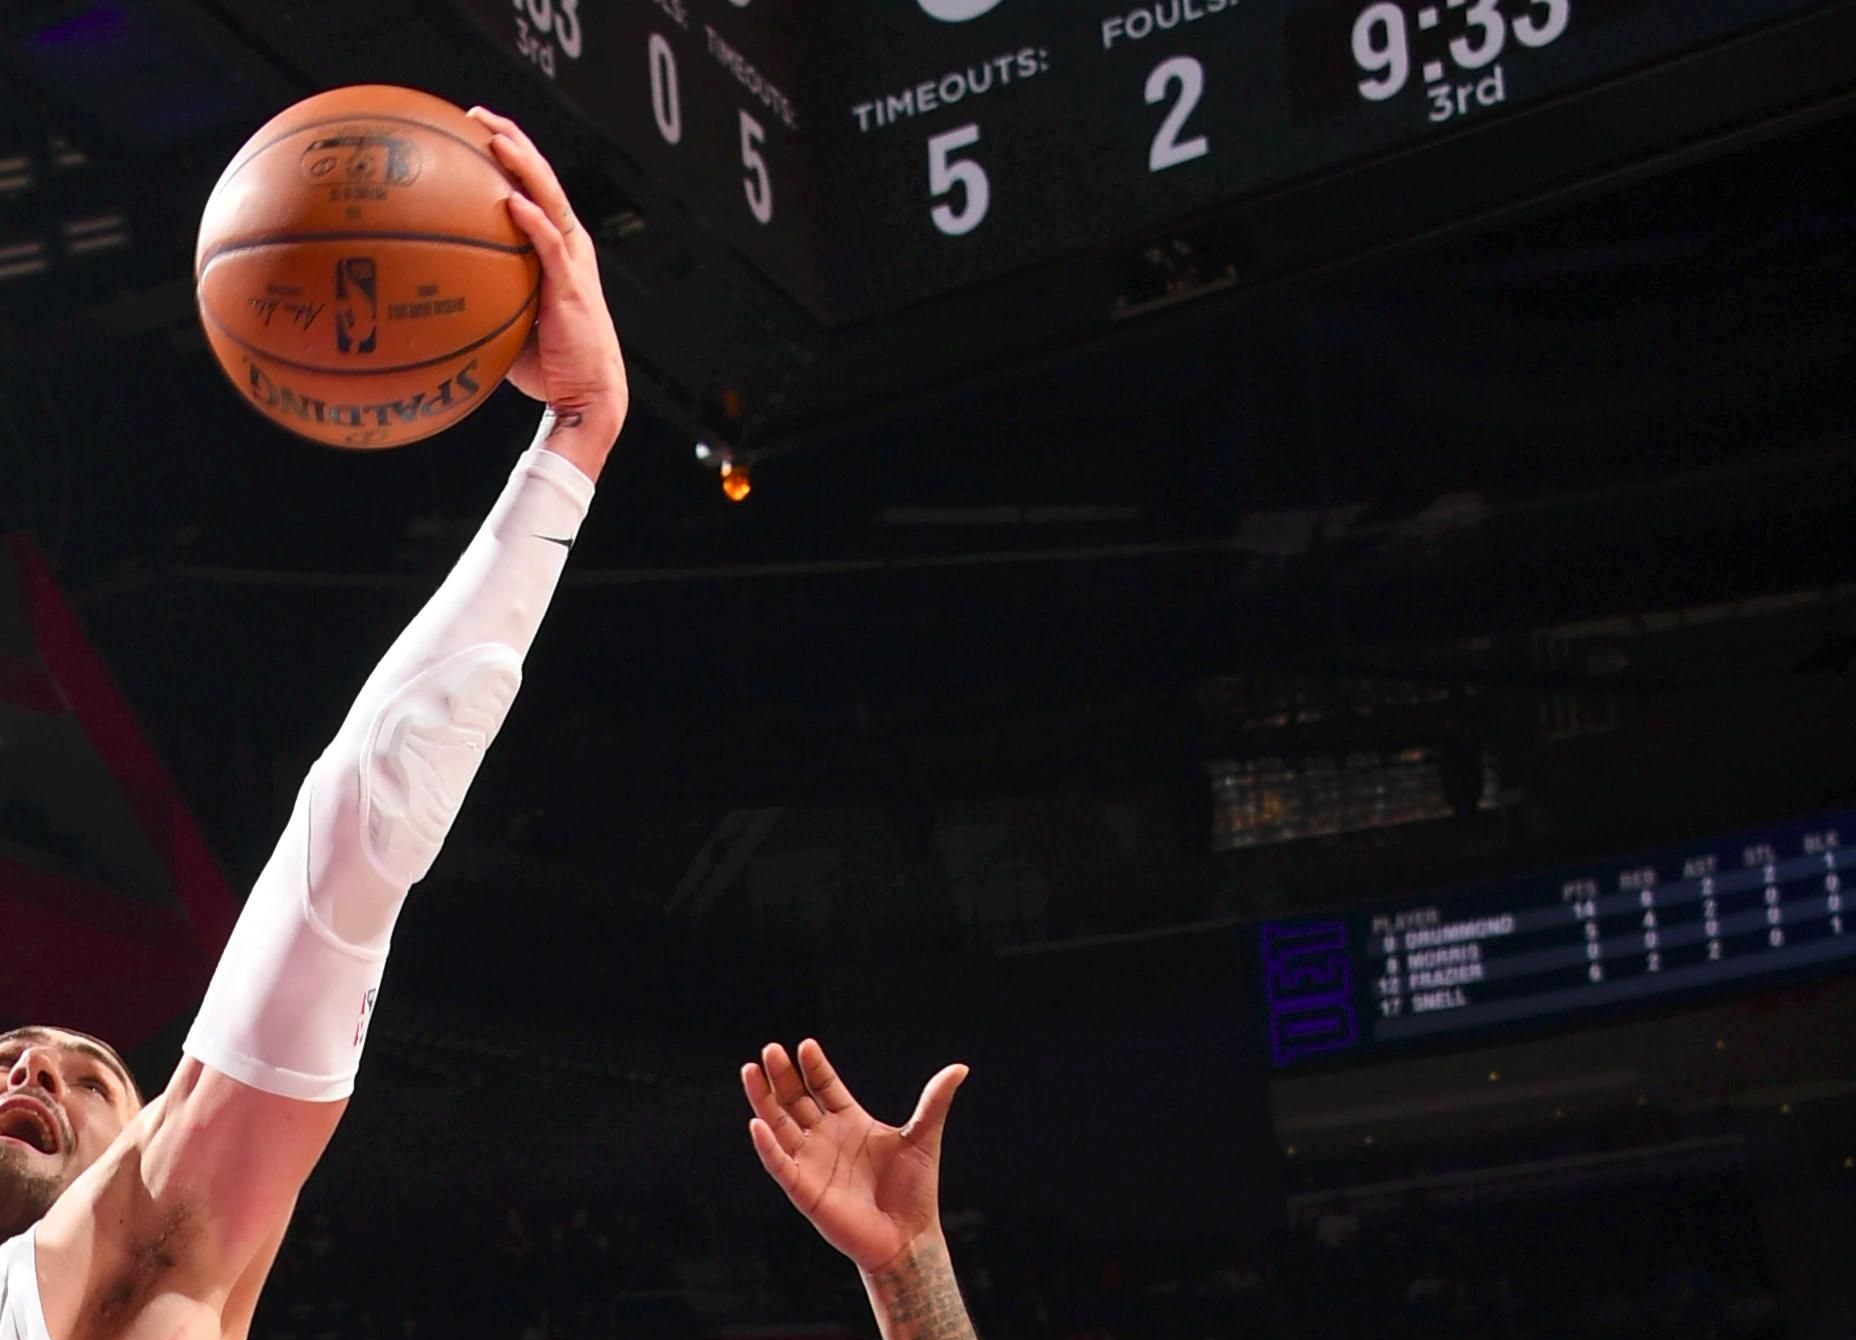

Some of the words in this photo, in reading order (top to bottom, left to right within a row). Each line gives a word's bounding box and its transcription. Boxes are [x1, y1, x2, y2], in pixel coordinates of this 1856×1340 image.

[648, 33, 682, 144] 0
[852, 47, 1049, 132] TIMEOUTS:
[1144, 55, 1209, 172] 2
[1427, 65, 1506, 122] 3rd
[739, 110, 773, 224] 5
[928, 122, 990, 236] 5
[1405, 914, 1515, 949] DRUMMOND
[1408, 943, 1481, 970] MORRIS
[1409, 963, 1483, 990] FRAZIER
[1412, 987, 1467, 1013] SNELL
